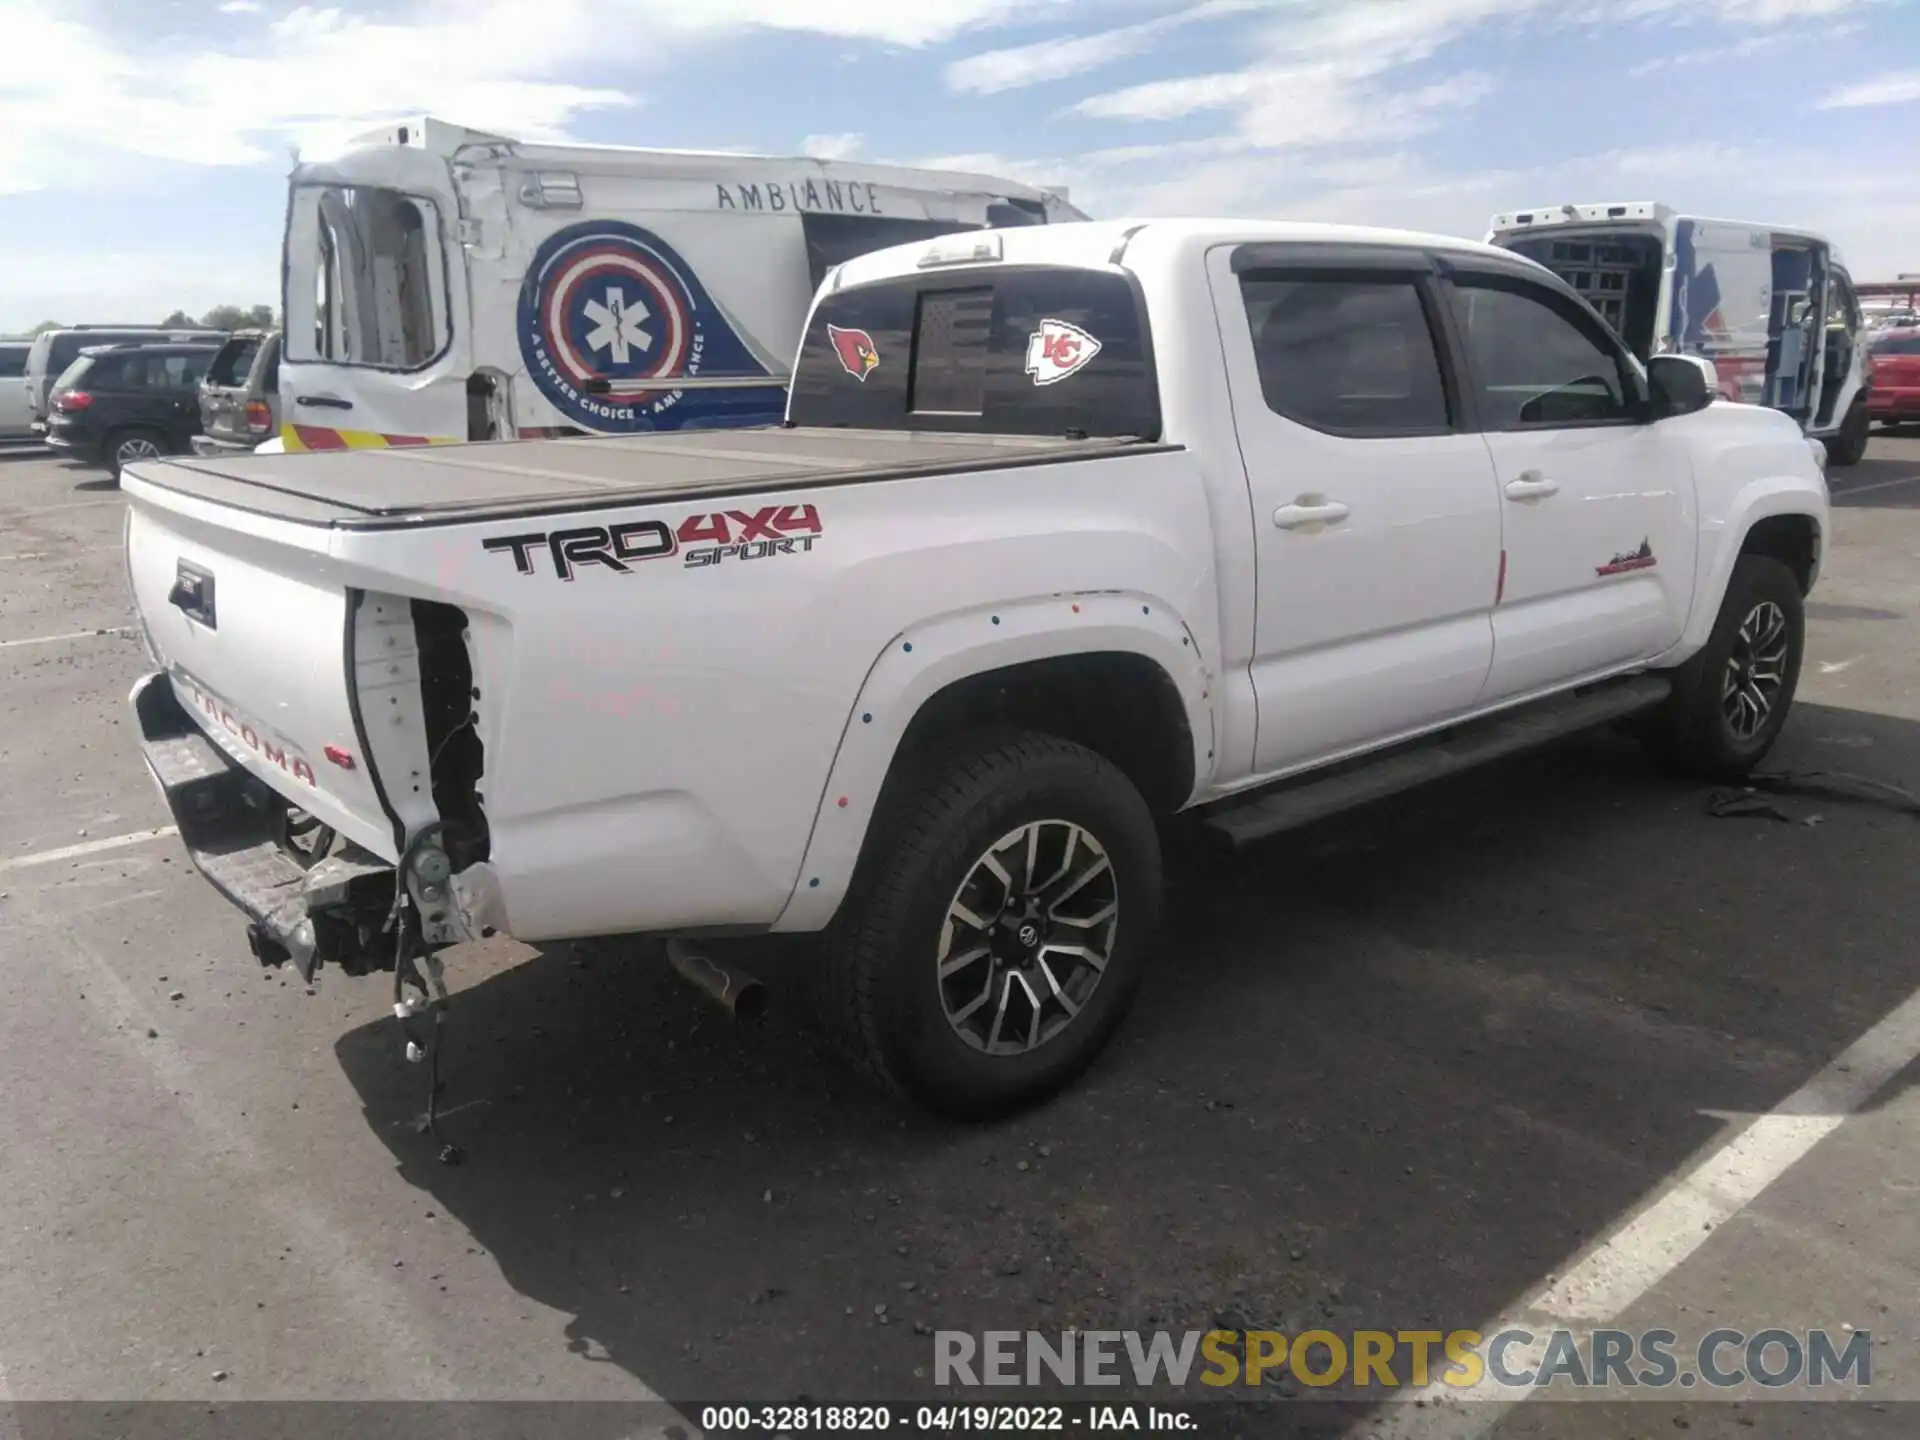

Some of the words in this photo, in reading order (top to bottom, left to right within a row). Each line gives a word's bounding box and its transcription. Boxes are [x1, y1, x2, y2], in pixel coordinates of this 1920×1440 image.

[531, 333, 542, 346] A
[1042, 333, 1081, 369] KC
[536, 348, 578, 401] BETTER
[654, 334, 704, 413] AMBANCE
[580, 397, 635, 420] CHOICE
[482, 519, 680, 582] TRD
[684, 534, 823, 569] SPORT
[193, 686, 316, 789] TACOMA
